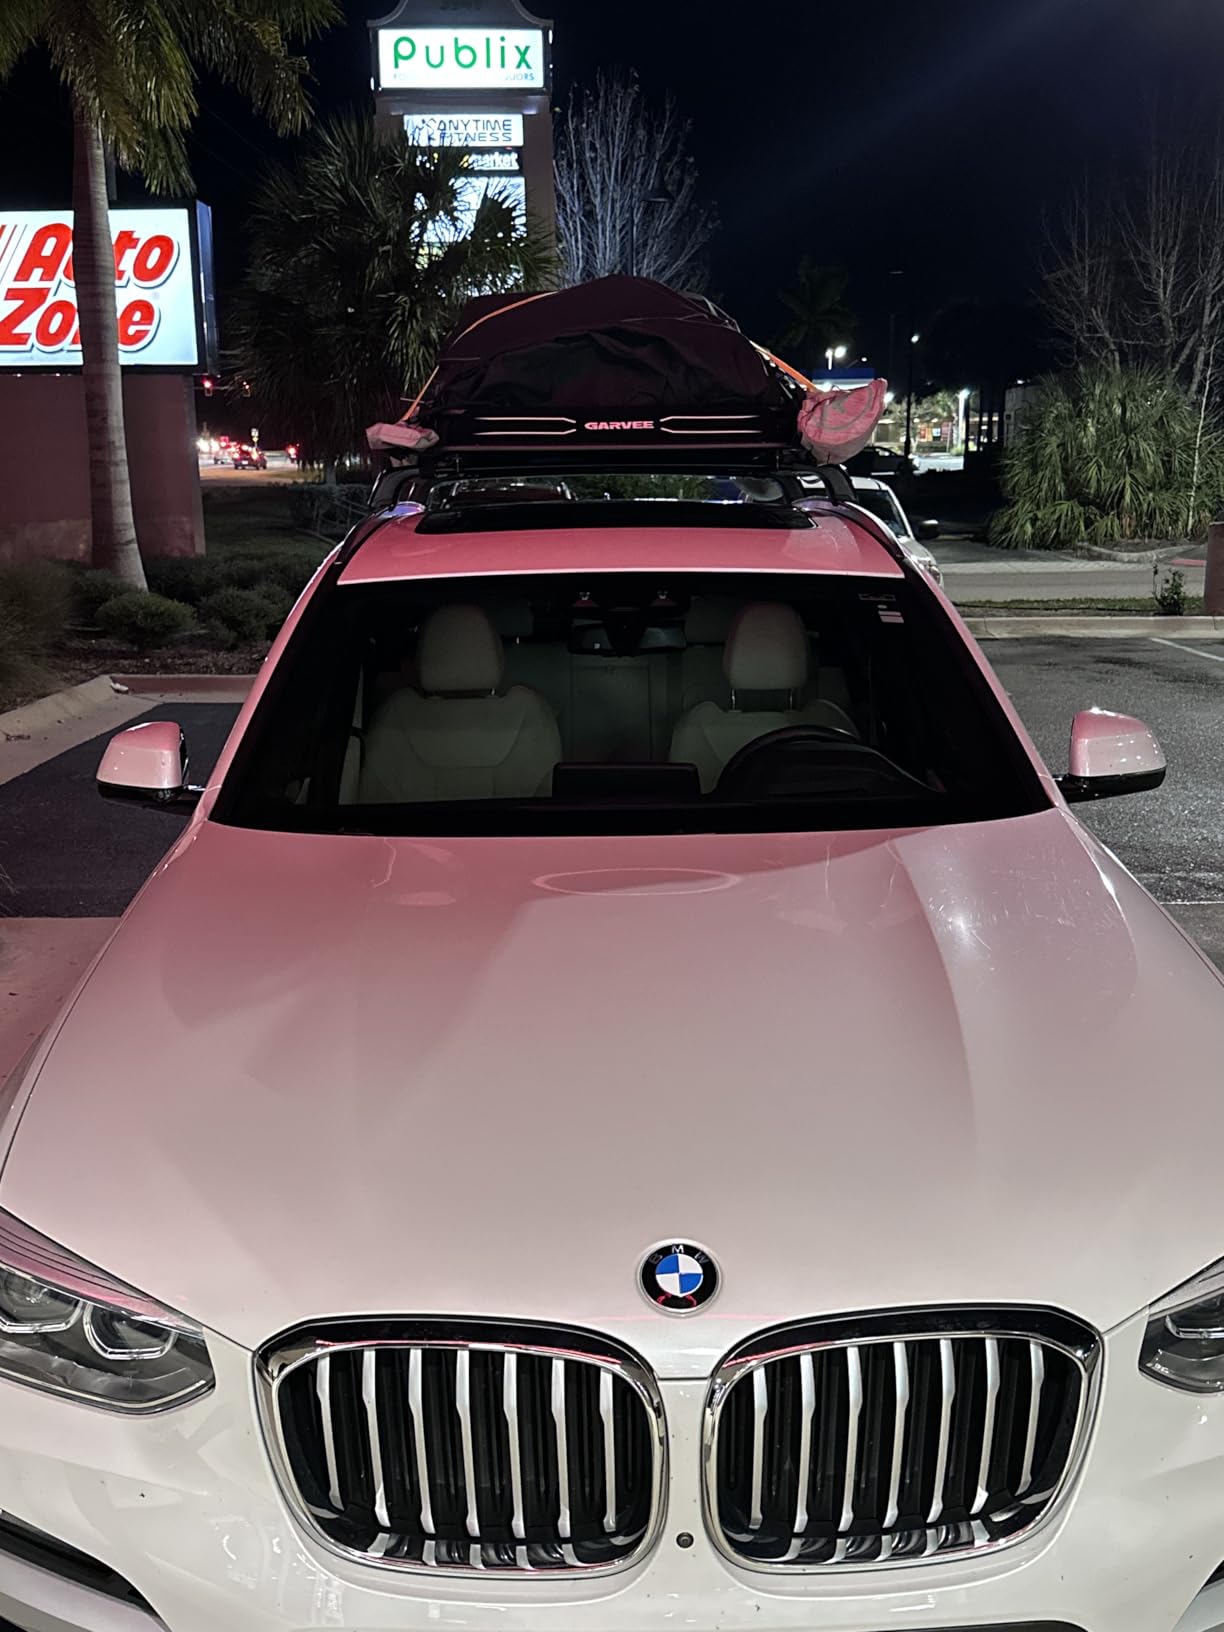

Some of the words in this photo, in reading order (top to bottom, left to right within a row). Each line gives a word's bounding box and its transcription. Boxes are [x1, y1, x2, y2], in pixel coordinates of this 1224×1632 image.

[394, 36, 532, 69] Publix
[437, 119, 512, 131] ANYTIME
[13, 223, 175, 282] Ato
[0, 287, 155, 347] Zoe
[584, 420, 655, 430] GARVEE
[648, 1243, 710, 1265] BMW
